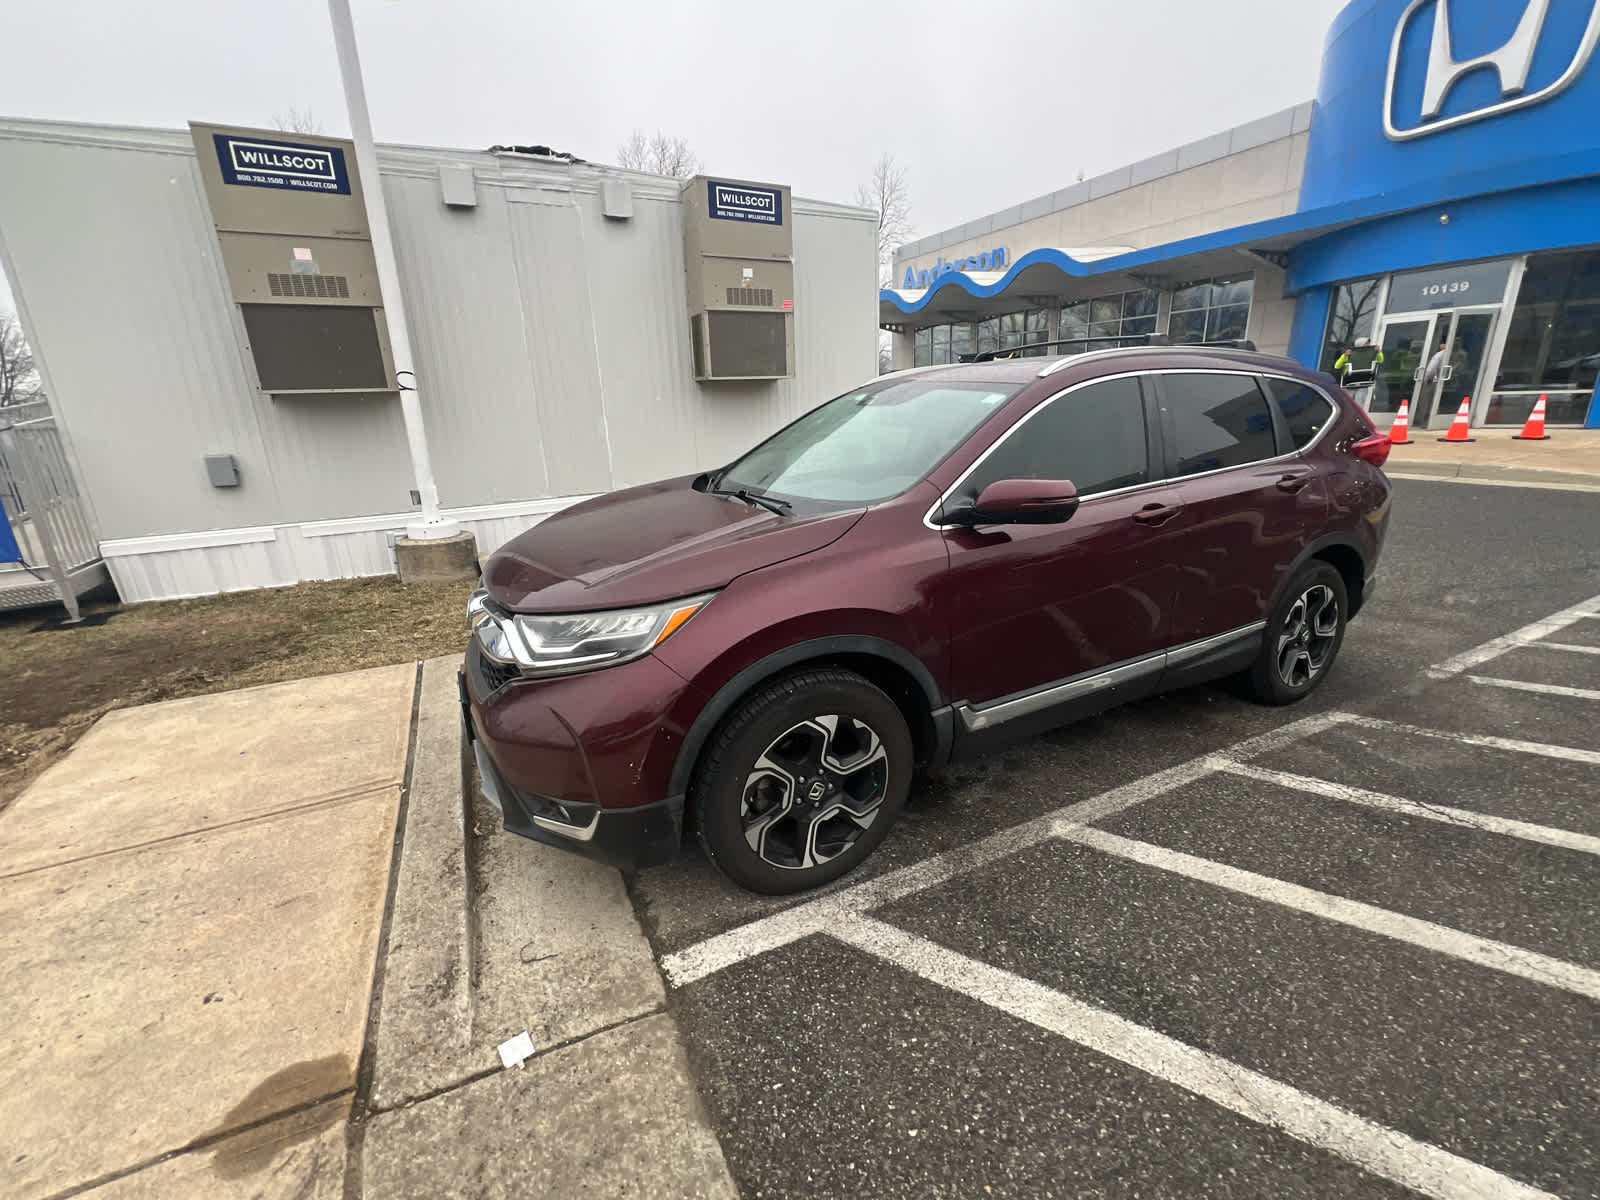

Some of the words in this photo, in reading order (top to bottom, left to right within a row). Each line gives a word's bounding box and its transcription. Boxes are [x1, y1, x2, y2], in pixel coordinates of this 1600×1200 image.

[240, 150, 325, 171] WILLSCOT
[721, 192, 771, 208] WILLSCOT
[1421, 281, 1470, 296] 10139
